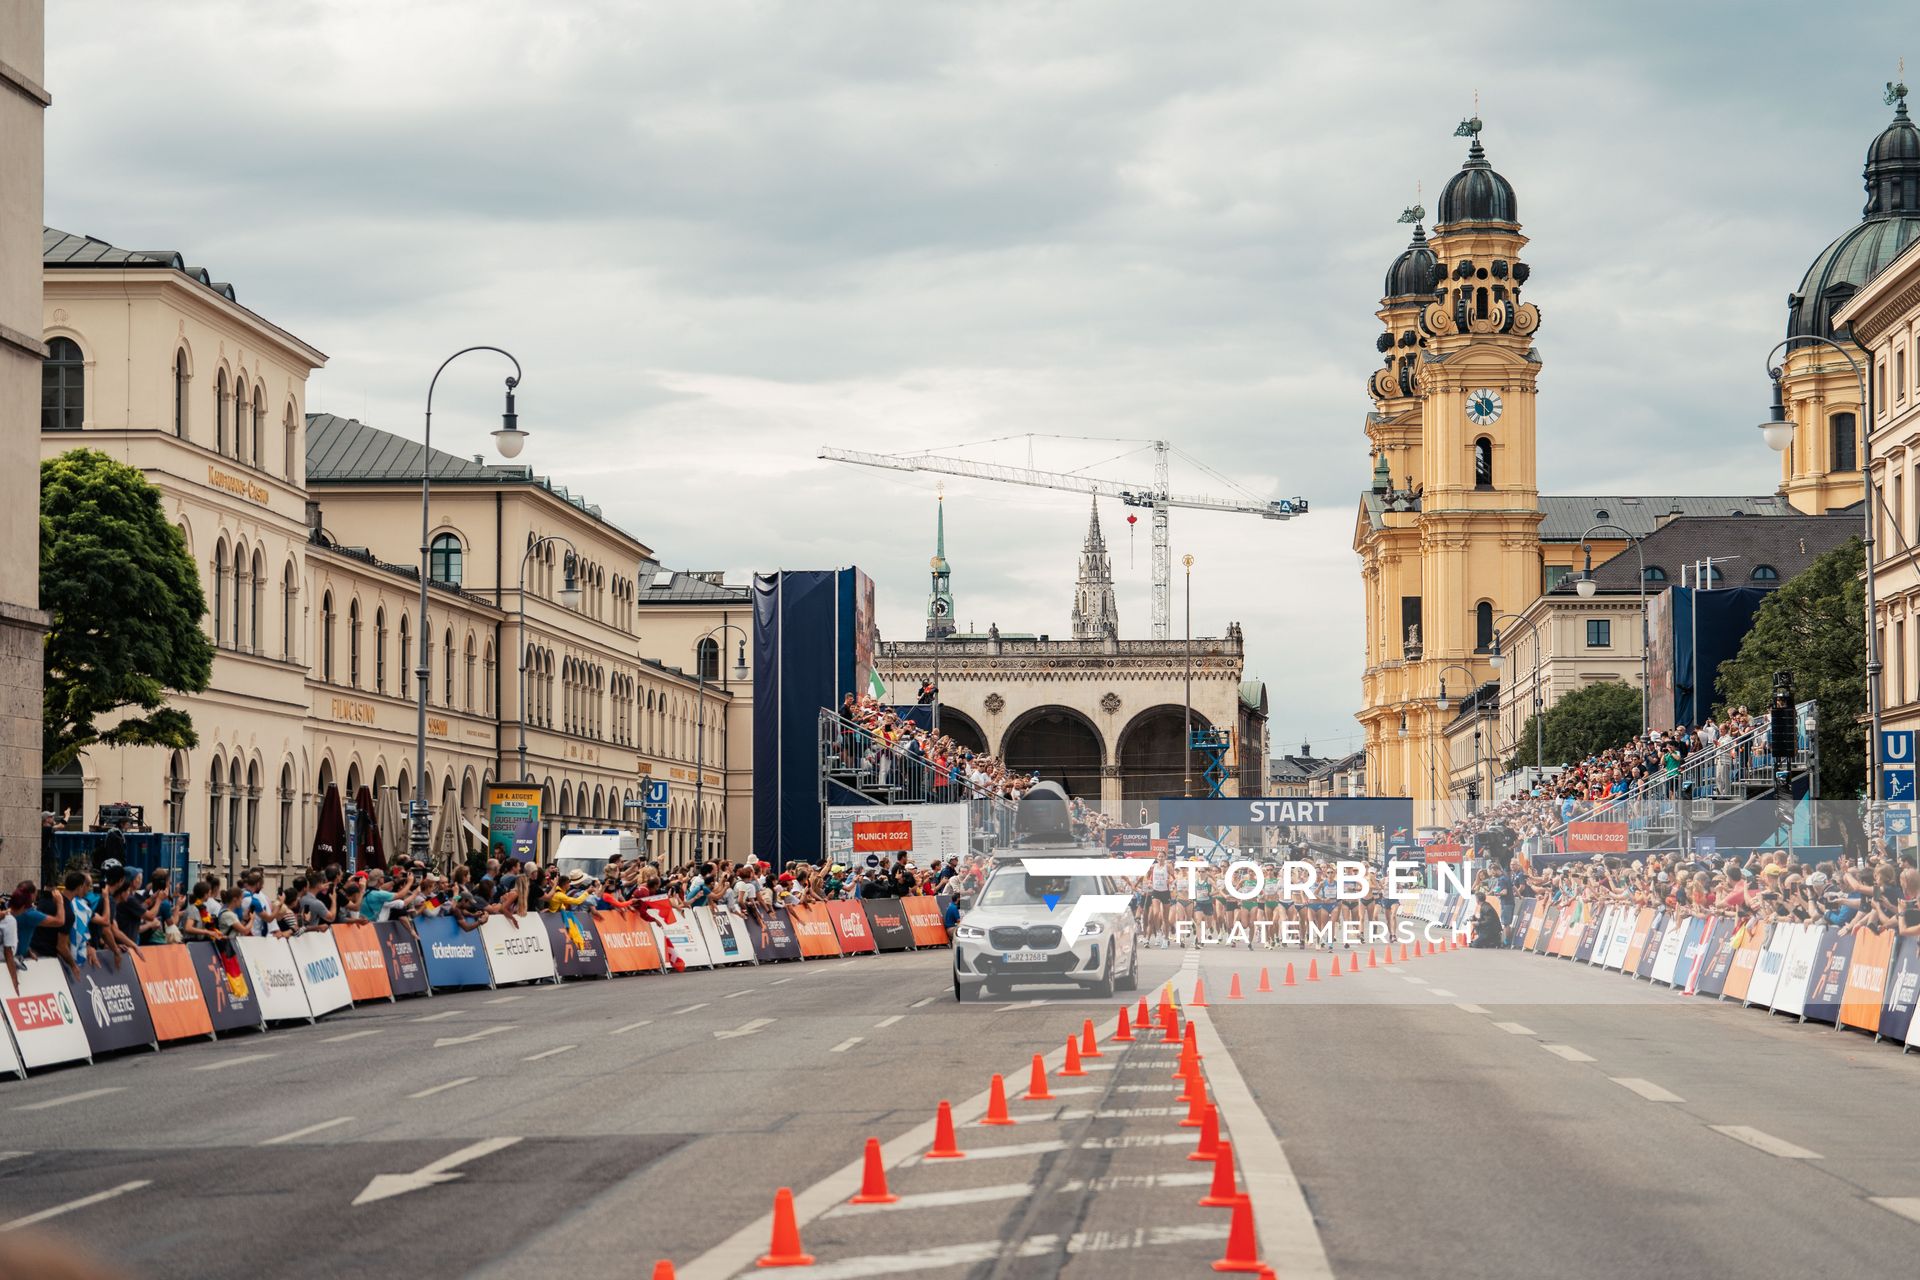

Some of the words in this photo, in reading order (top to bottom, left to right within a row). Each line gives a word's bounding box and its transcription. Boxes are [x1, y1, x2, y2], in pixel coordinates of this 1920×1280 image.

[1887, 735, 1906, 759] U
[650, 784, 663, 800] U
[1250, 801, 1329, 822] START
[857, 832, 887, 840] MUNICH
[889, 832, 908, 840] 2022
[1571, 833, 1603, 841] MUNICH
[1604, 833, 1624, 842] 2022
[797, 922, 817, 936] MUNICH
[817, 922, 831, 935] 2022
[911, 914, 928, 927] MUNICH
[929, 913, 942, 926] 2022
[505, 936, 544, 956] REGUPOL
[604, 932, 633, 949] MUNICH
[633, 931, 652, 947] 2022
[432, 941, 475, 959] ticketmaster
[344, 951, 368, 971] MUNICH
[367, 949, 384, 969] 2022
[306, 956, 339, 985] MONDO
[101, 983, 131, 1000] EUROPEAN
[145, 979, 176, 1005] MUNICH
[174, 977, 199, 1001] 2022
[18, 997, 61, 1025] SPAR
[106, 998, 135, 1014] ATHLETICS
